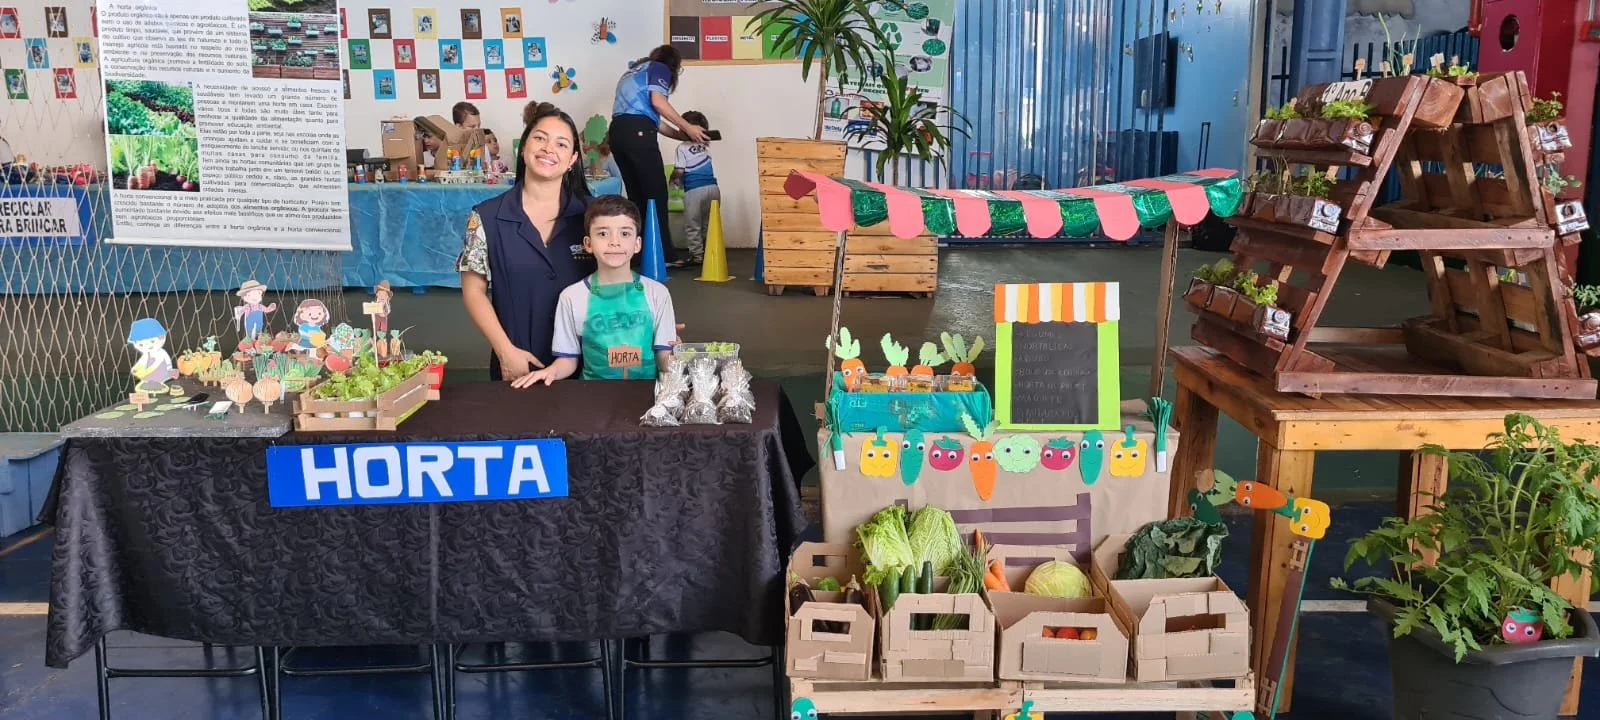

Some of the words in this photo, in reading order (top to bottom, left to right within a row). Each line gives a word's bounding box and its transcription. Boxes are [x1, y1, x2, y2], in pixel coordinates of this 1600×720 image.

[16, 218, 67, 232] BRINCAR
[610, 352, 640, 364] HORTA
[301, 445, 550, 500] HORTA
